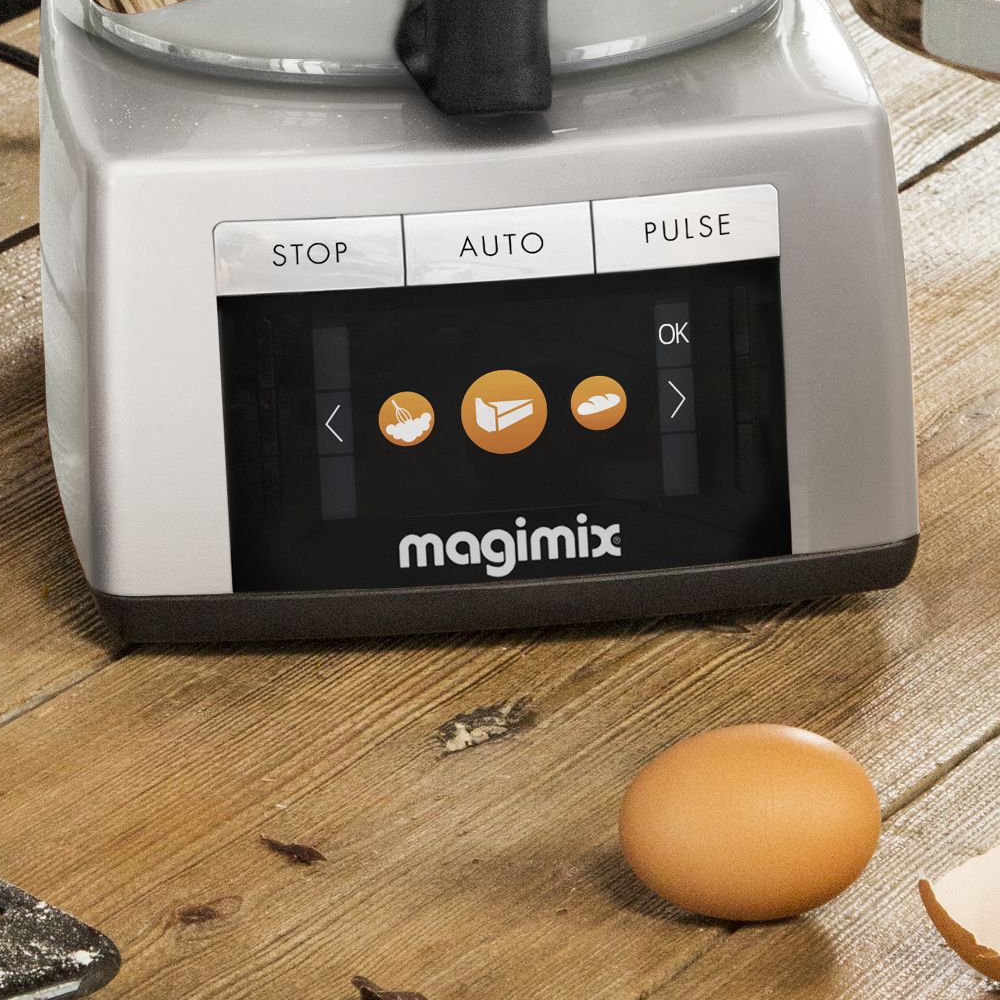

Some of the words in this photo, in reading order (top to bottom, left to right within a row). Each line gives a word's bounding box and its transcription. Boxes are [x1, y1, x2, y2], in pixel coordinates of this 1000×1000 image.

[645, 213, 731, 243] PULSE
[272, 242, 348, 266] STOP
[460, 232, 545, 257] AUTO
[658, 322, 690, 345] OK
[399, 513, 622, 577] magimix
